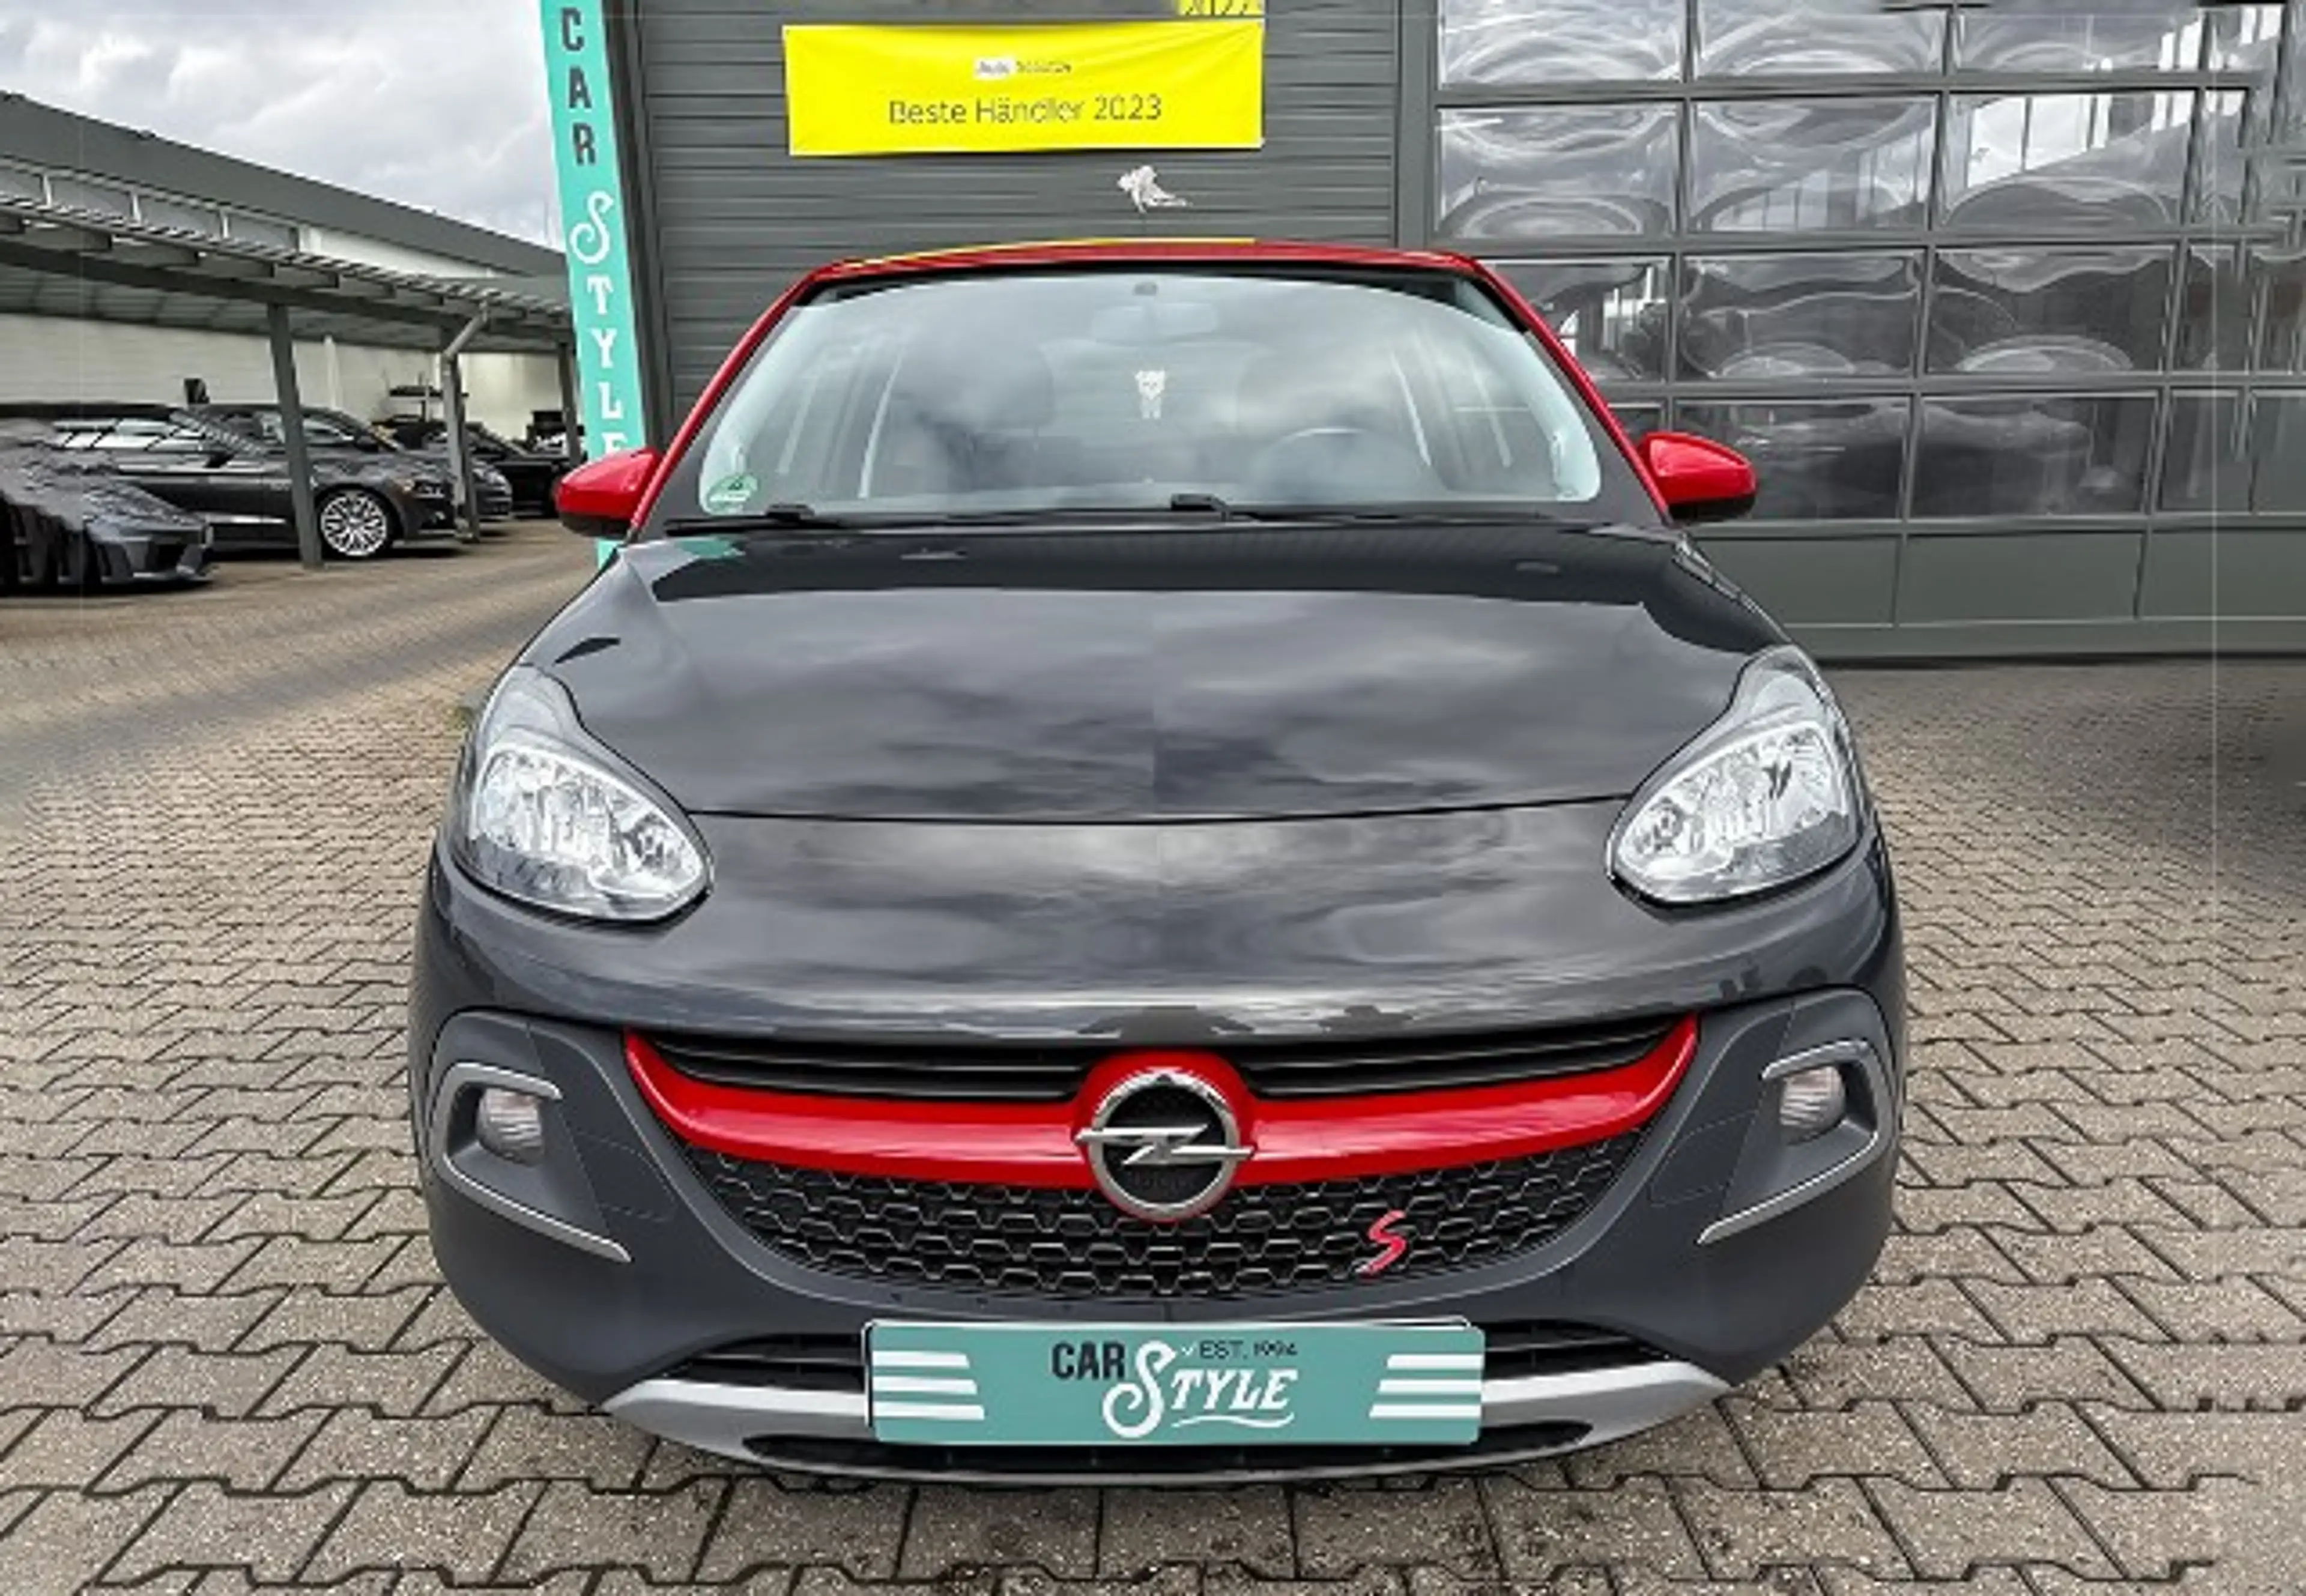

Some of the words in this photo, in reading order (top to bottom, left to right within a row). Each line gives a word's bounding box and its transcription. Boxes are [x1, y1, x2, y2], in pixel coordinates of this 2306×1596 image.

[561, 7, 596, 166] CAR
[889, 100, 967, 124] Beste
[975, 97, 1085, 124] Händler
[1093, 94, 1162, 121] 2023
[1356, 1209, 1407, 1275] S
[1200, 1340, 1248, 1359] EST.
[1052, 1341, 1125, 1380] CAR
[1103, 1340, 1298, 1438] STYLE
